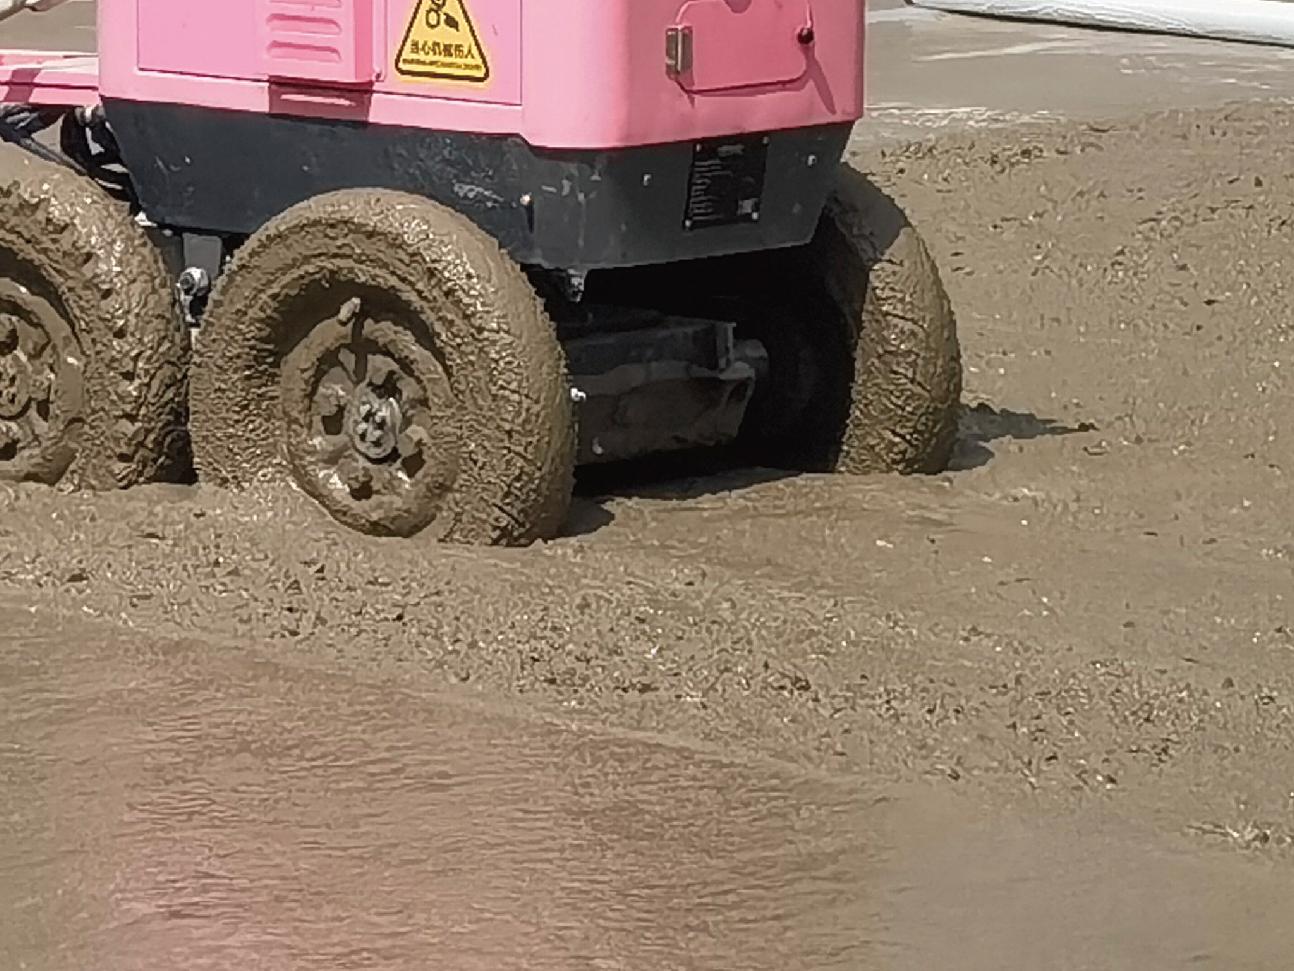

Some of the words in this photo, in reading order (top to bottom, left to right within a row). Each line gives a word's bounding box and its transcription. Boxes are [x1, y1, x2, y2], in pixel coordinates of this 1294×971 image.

[410, 39, 475, 58] 当心机械伤人
